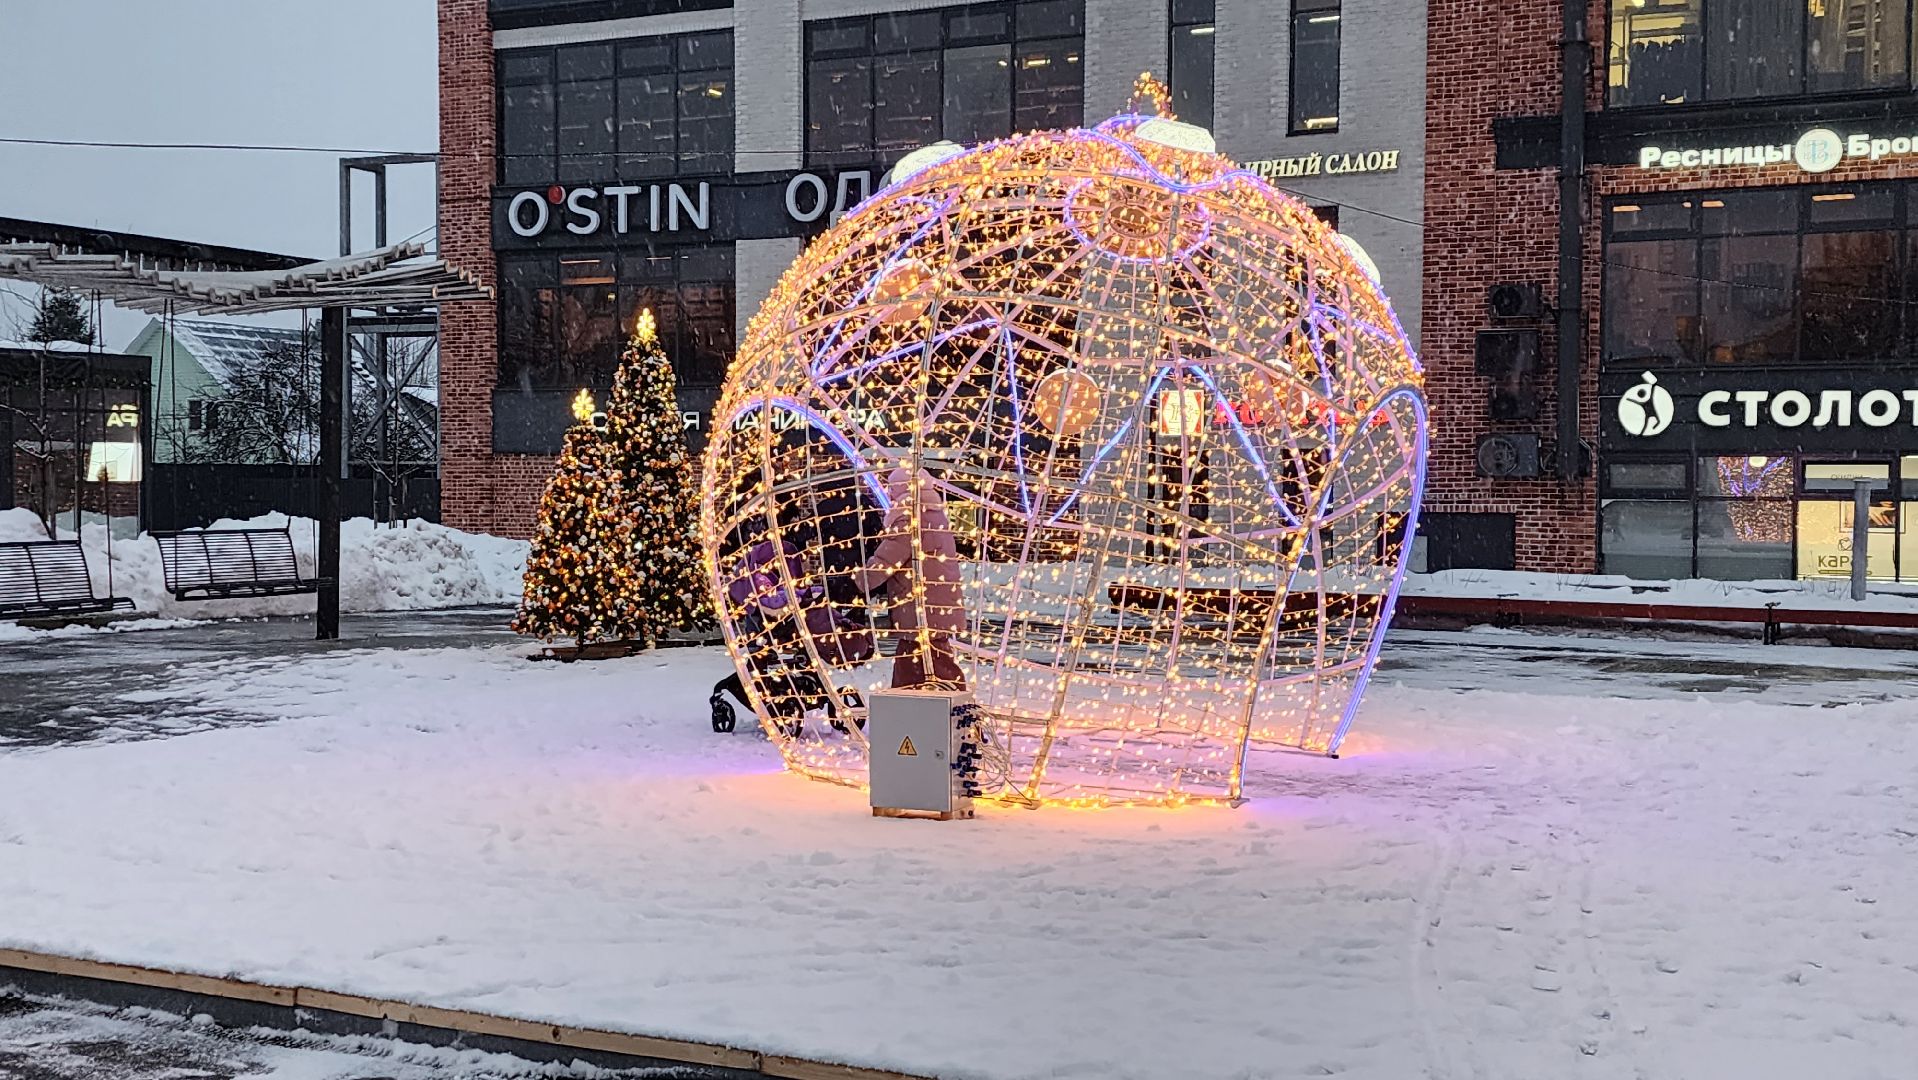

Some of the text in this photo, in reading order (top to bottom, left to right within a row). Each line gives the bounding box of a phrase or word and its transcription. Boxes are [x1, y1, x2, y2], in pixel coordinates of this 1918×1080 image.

[1237, 149, 1400, 178] ИРНЫЙ САЛОН
[1640, 144, 1791, 168] Ресницы
[508, 181, 710, 237] O'STIN
[785, 171, 893, 232] ОД
